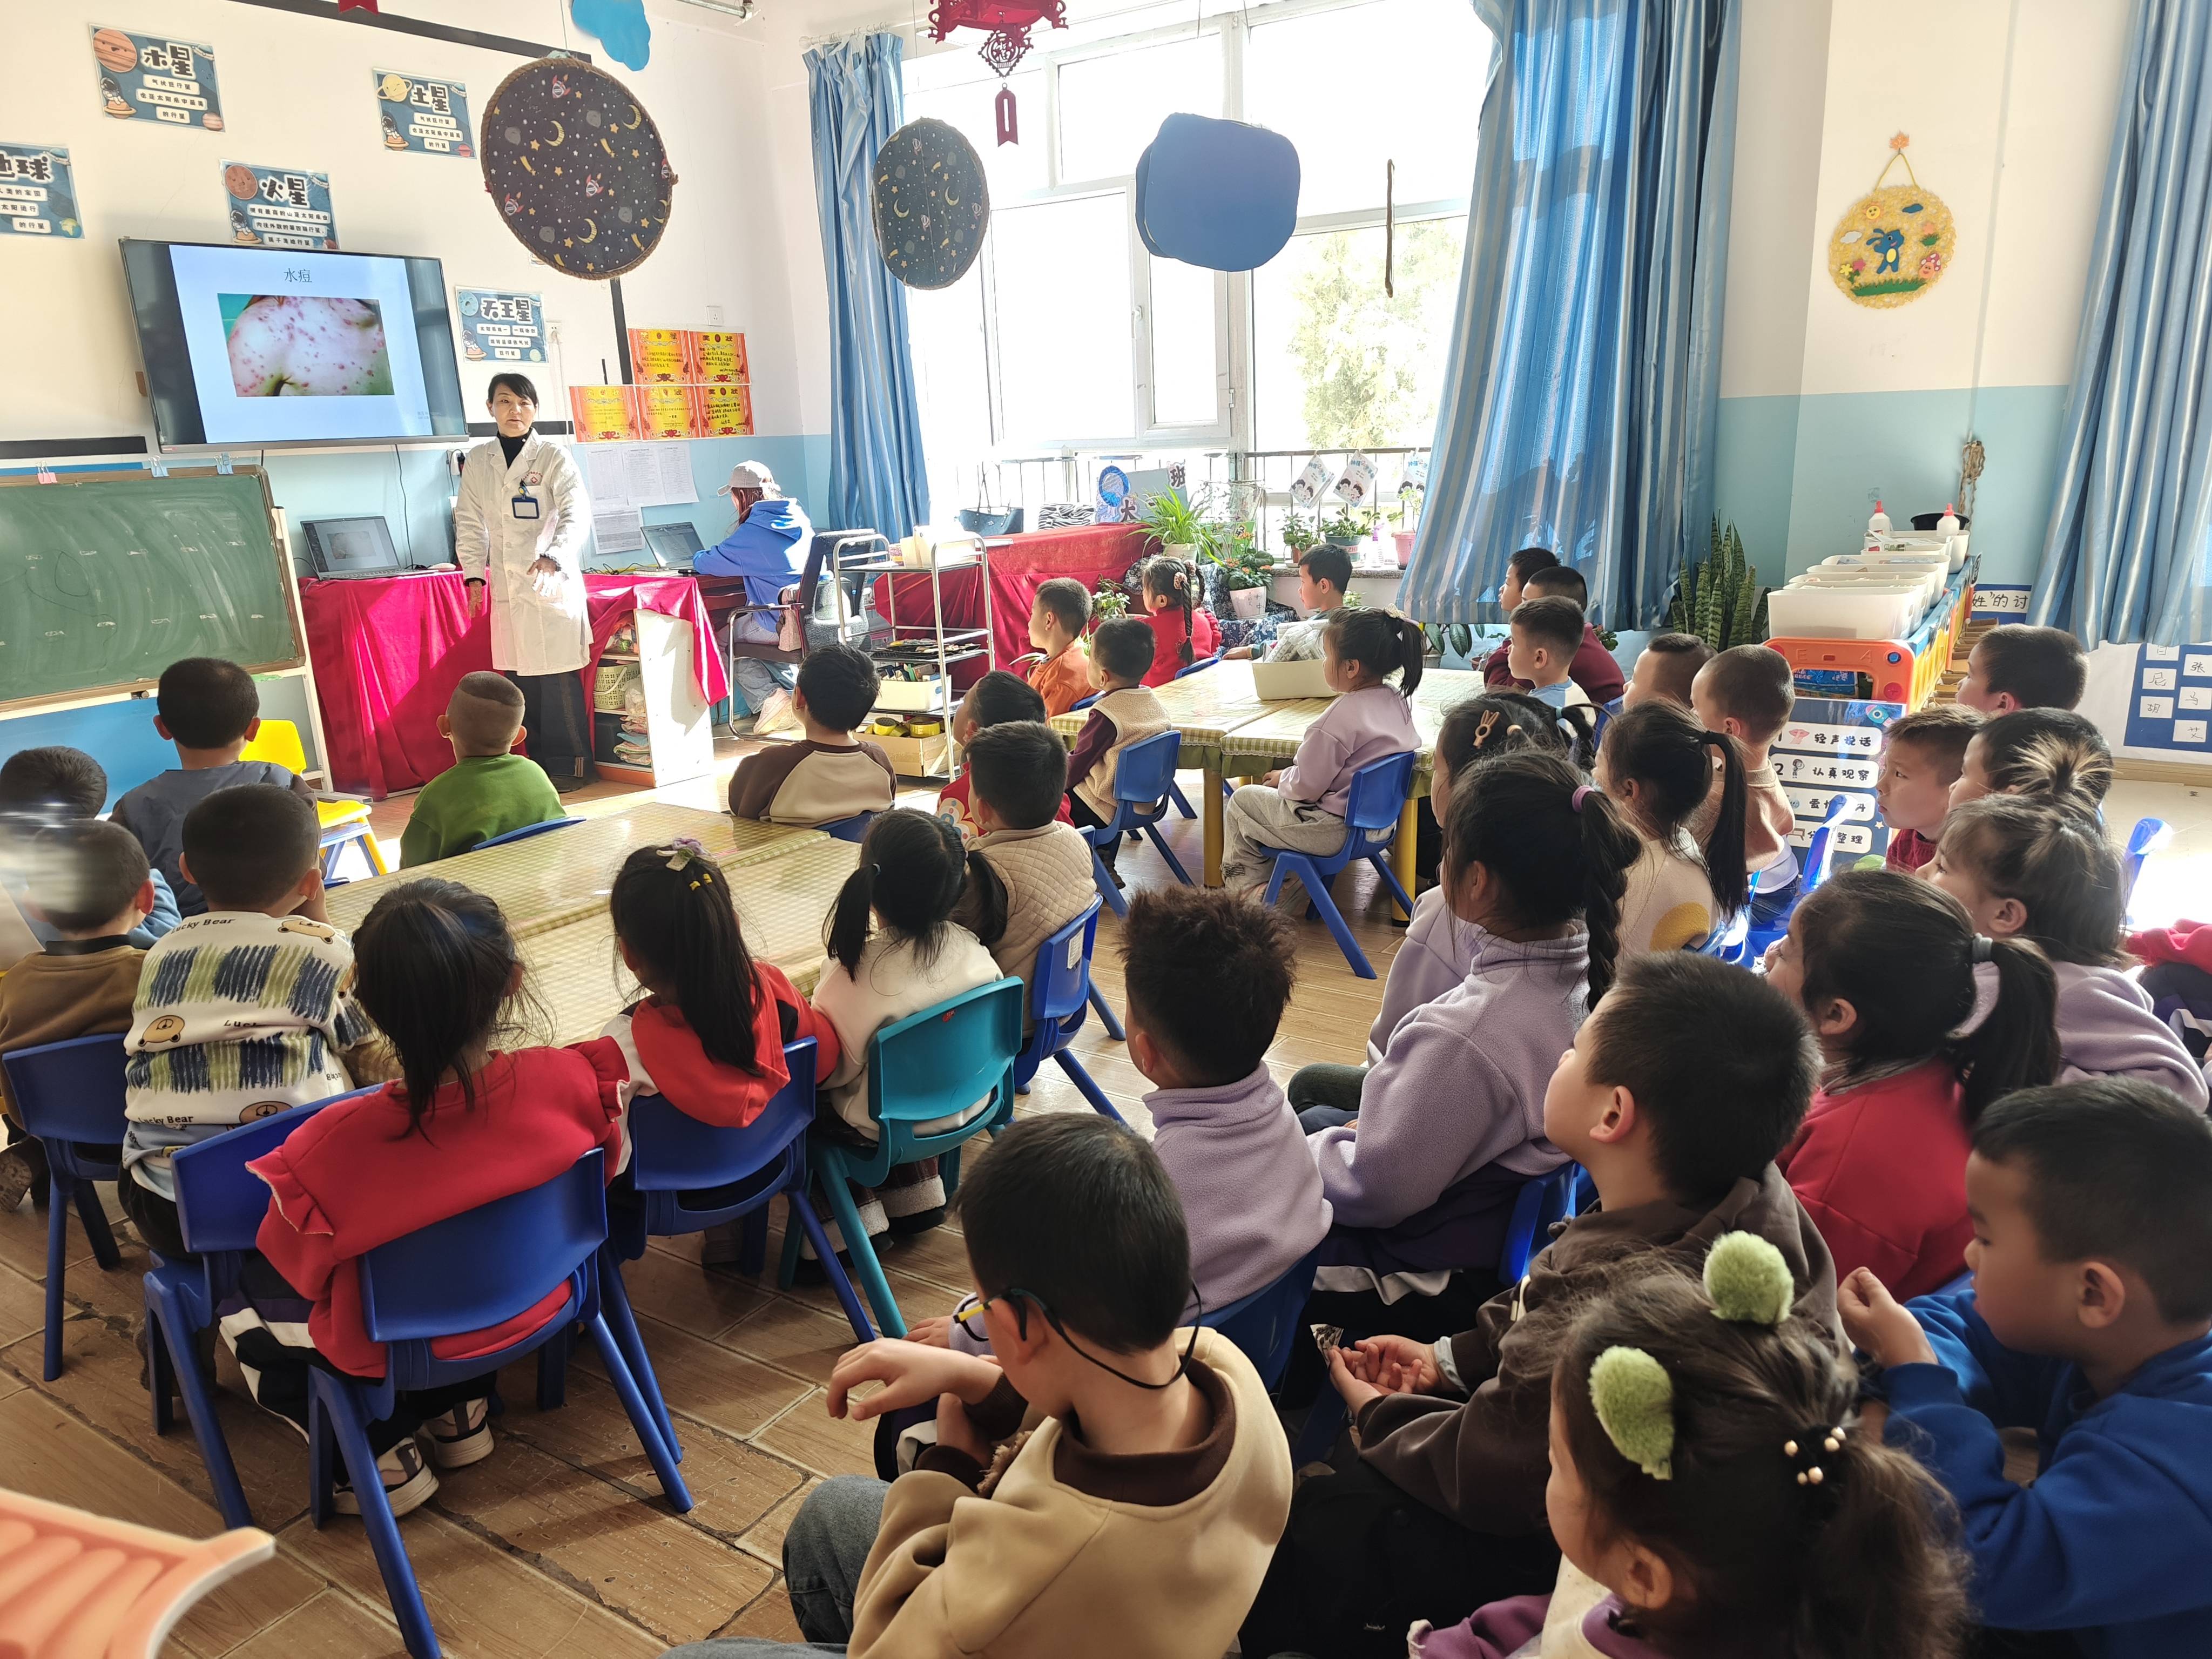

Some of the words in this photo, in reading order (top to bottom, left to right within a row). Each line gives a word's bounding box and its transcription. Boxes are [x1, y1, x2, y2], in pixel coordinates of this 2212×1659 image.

[144, 45, 192, 76] 木星
[413, 85, 449, 112] 土星
[163, 111, 185, 119] 的行星
[261, 177, 307, 206] 火星
[19, 221, 45, 230] 的行星
[284, 267, 312, 284] 水痘
[483, 299, 531, 322] 天王星
[1121, 500, 1138, 522] 大
[2190, 662, 2206, 673] 张
[2147, 703, 2161, 713] 胡
[1814, 733, 1872, 747] 轻声说话
[1812, 766, 1870, 781] 认真观察
[1808, 830, 1863, 845] 分整理
[171, 921, 200, 934] Lucky
[167, 1116, 194, 1124] Bear
